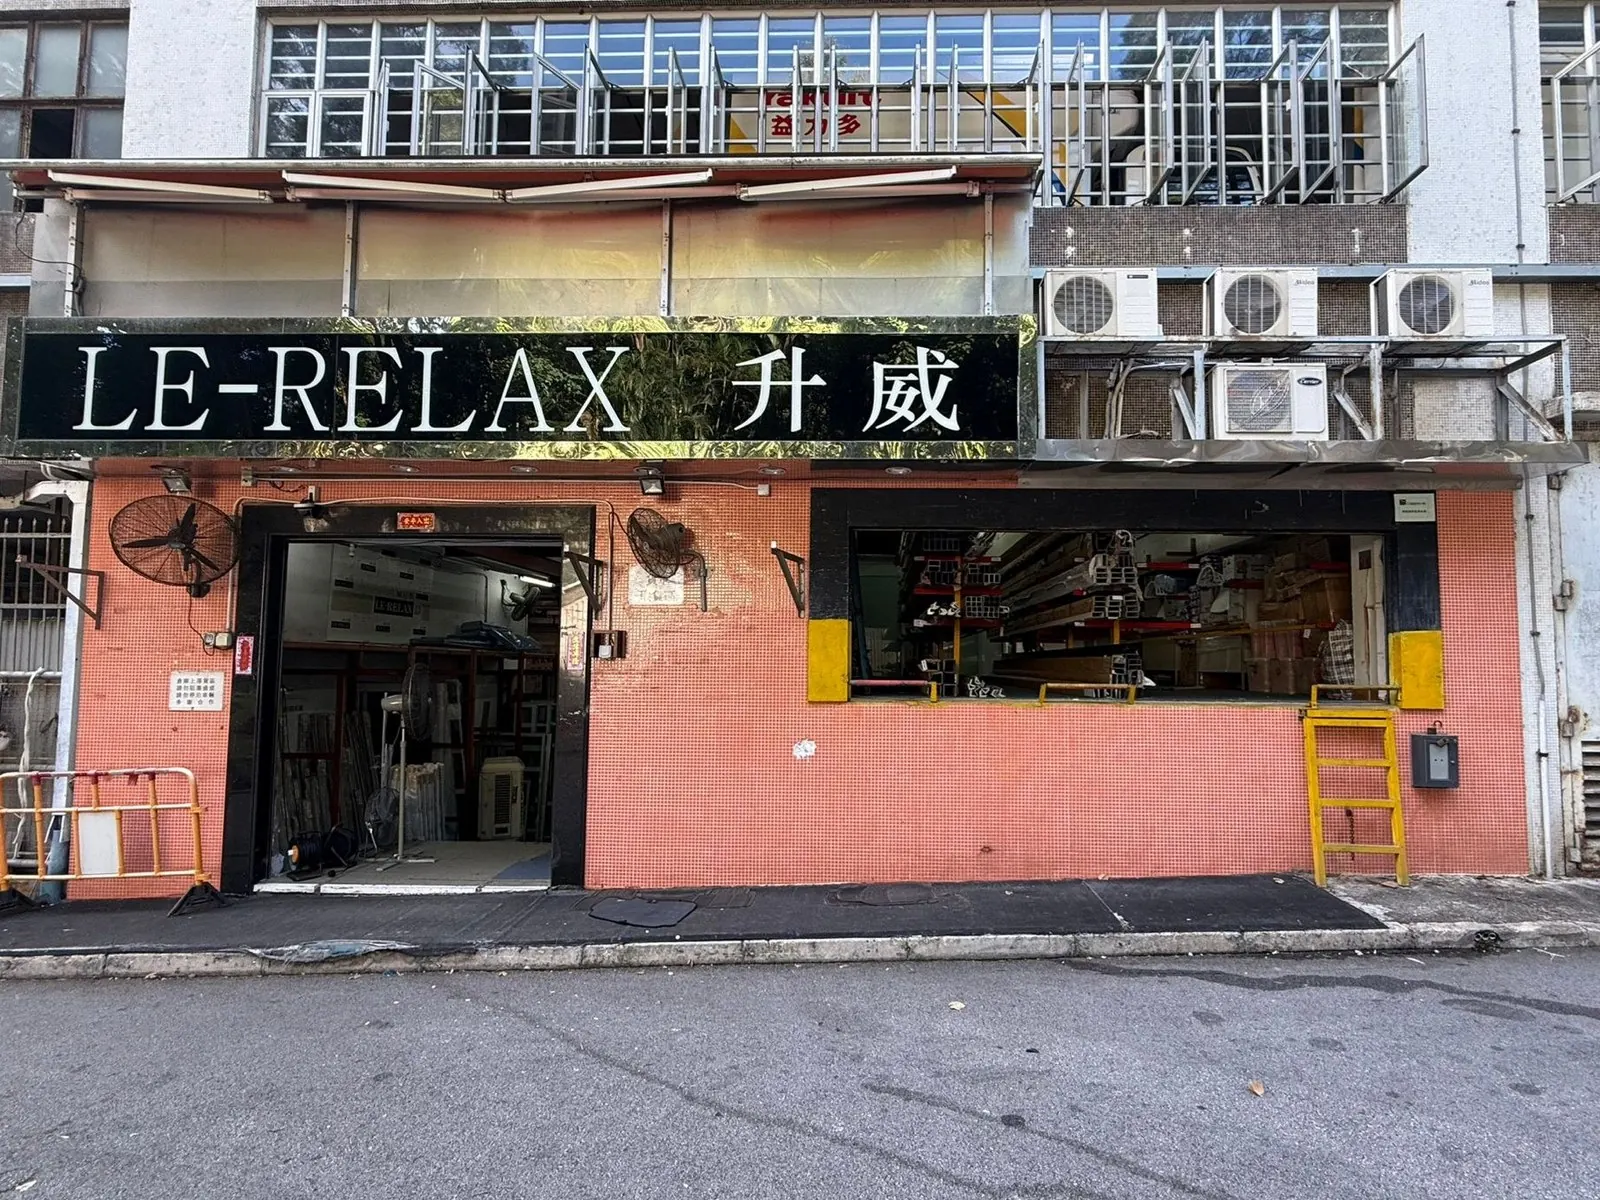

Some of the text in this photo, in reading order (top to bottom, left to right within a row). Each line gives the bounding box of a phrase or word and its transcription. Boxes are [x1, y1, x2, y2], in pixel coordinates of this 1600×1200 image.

[771, 113, 861, 136] 益力多
[72, 346, 960, 432] LE-RELAX 升威
